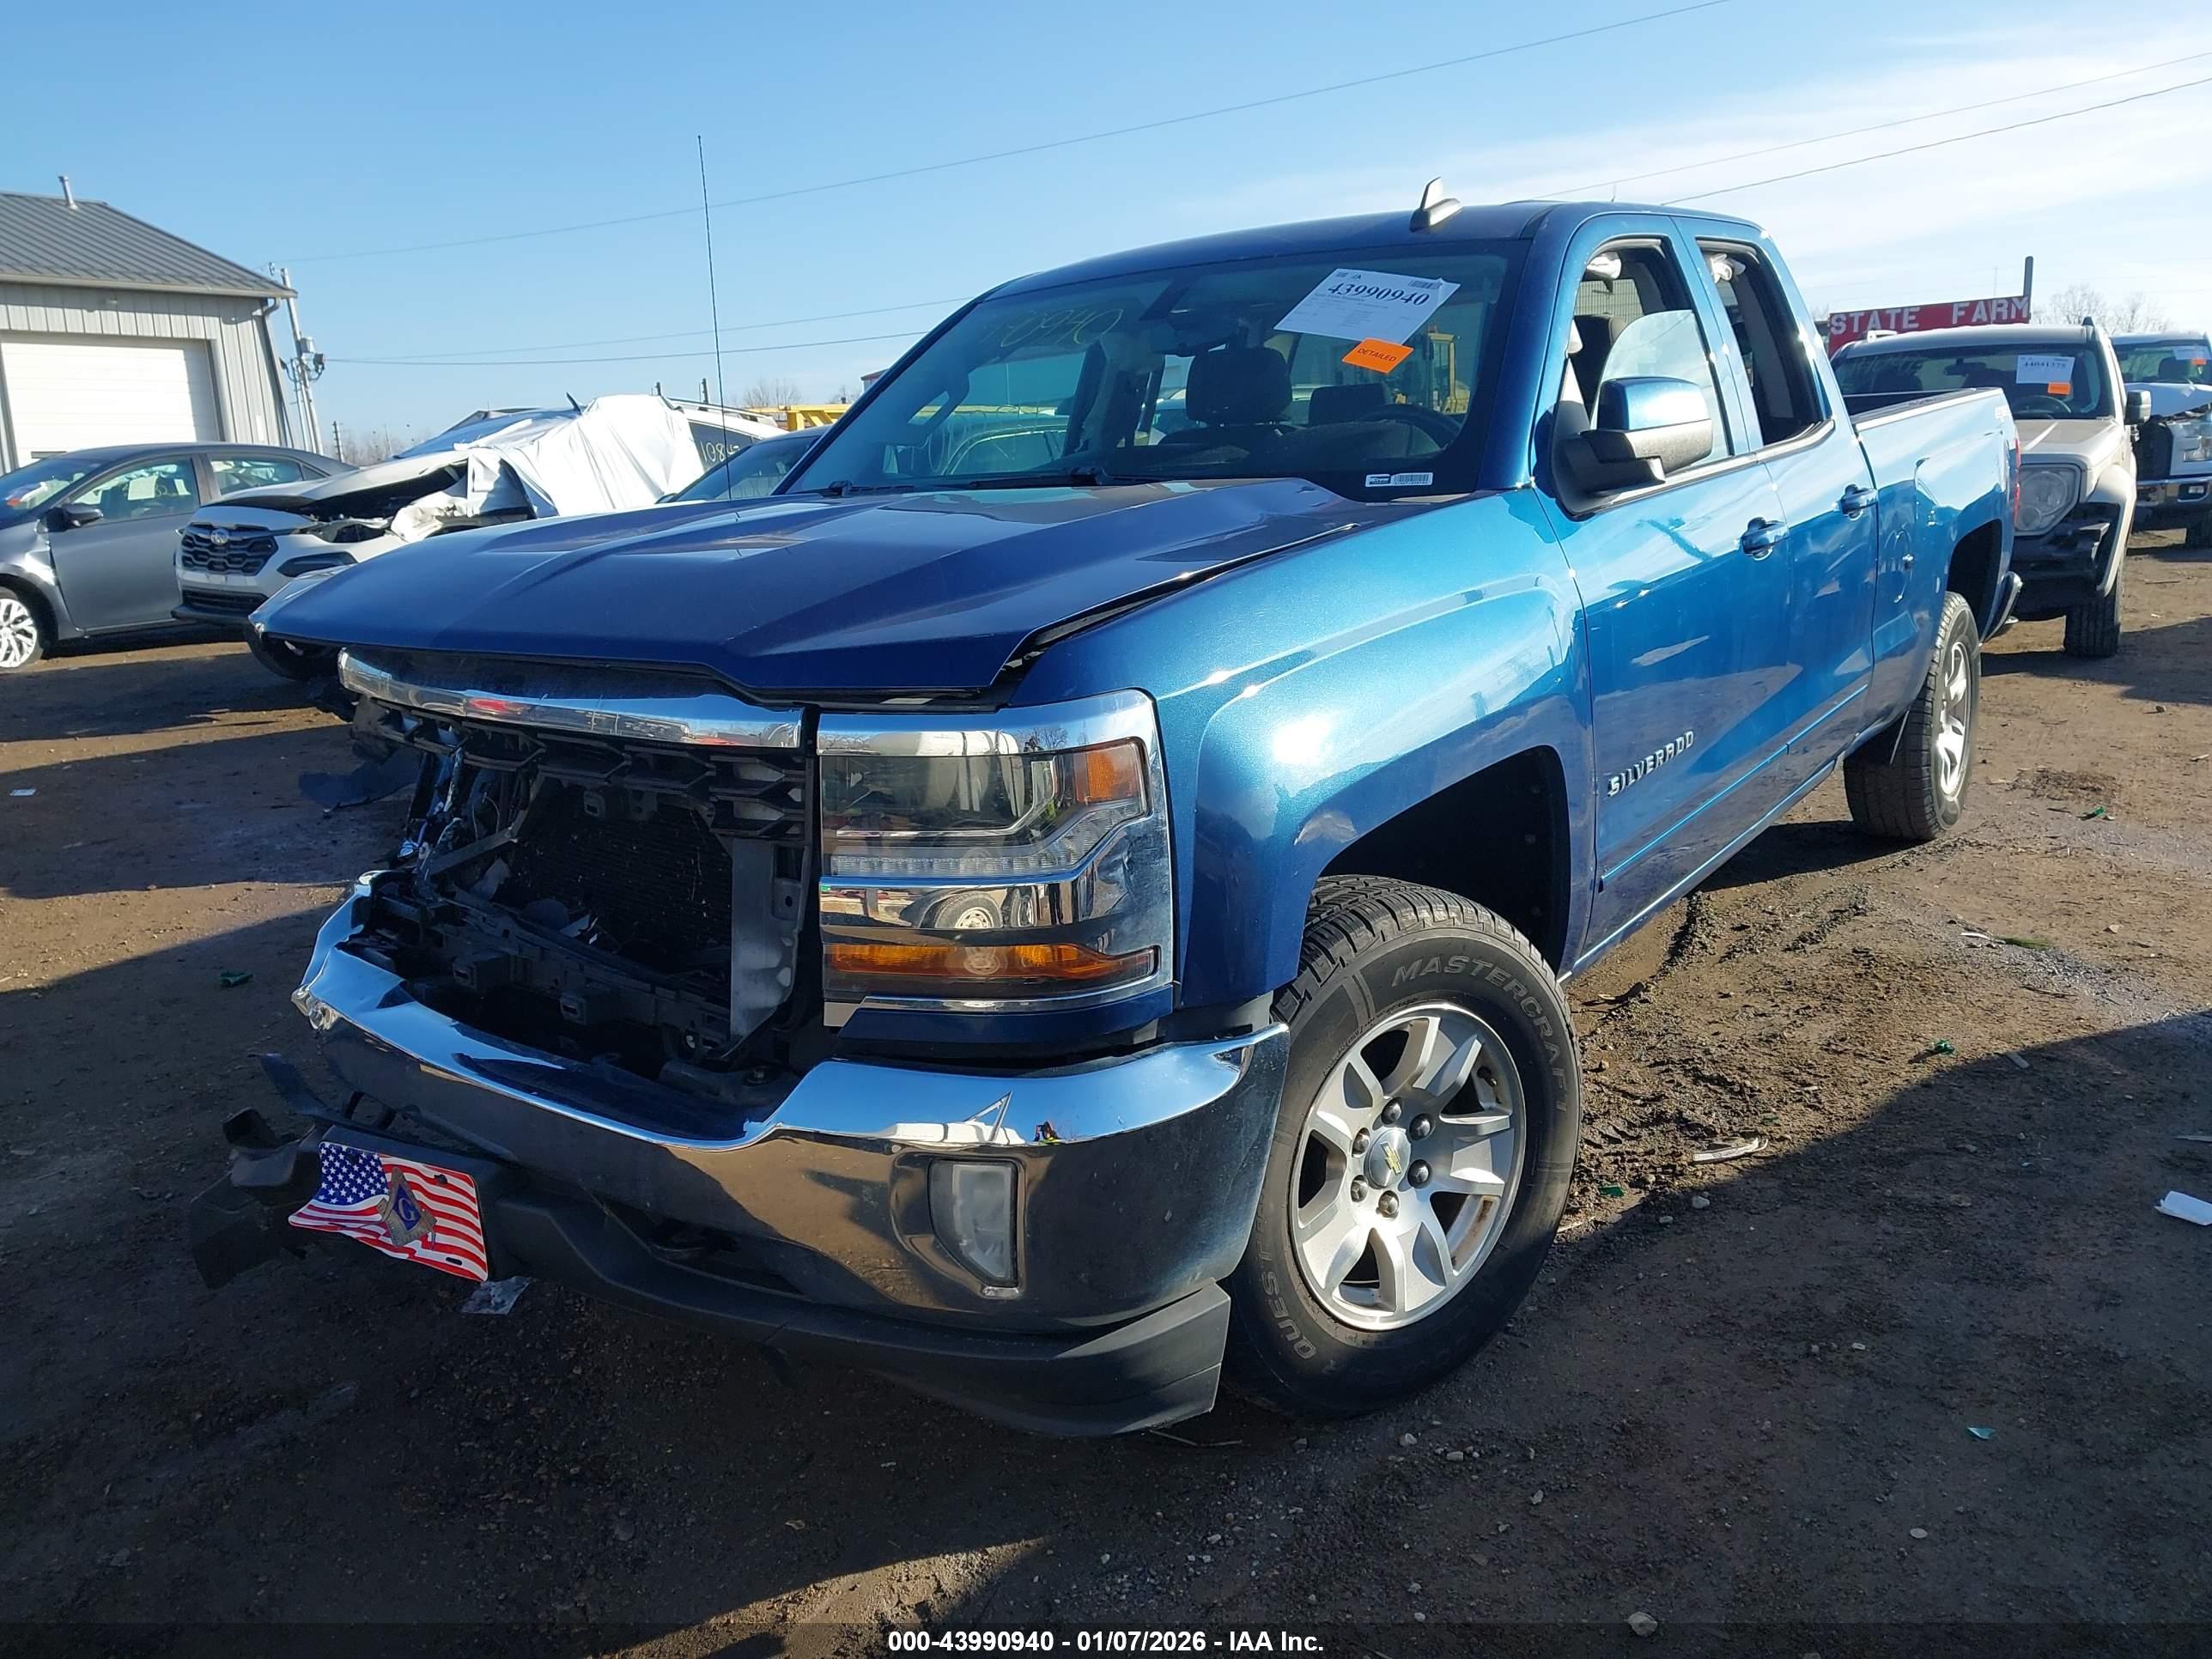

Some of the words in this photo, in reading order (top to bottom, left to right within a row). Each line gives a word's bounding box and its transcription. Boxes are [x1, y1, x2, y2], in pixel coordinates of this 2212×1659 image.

[1328, 283, 1430, 306] 43990940
[1830, 307, 1921, 335] STATE
[1952, 296, 2028, 325] FARM
[1357, 348, 1397, 362] DETAILED
[1607, 730, 1694, 797] SILVERADO
[1391, 955, 1568, 1114] MASTERCRAFT
[1255, 1242, 1318, 1360] QUEST
